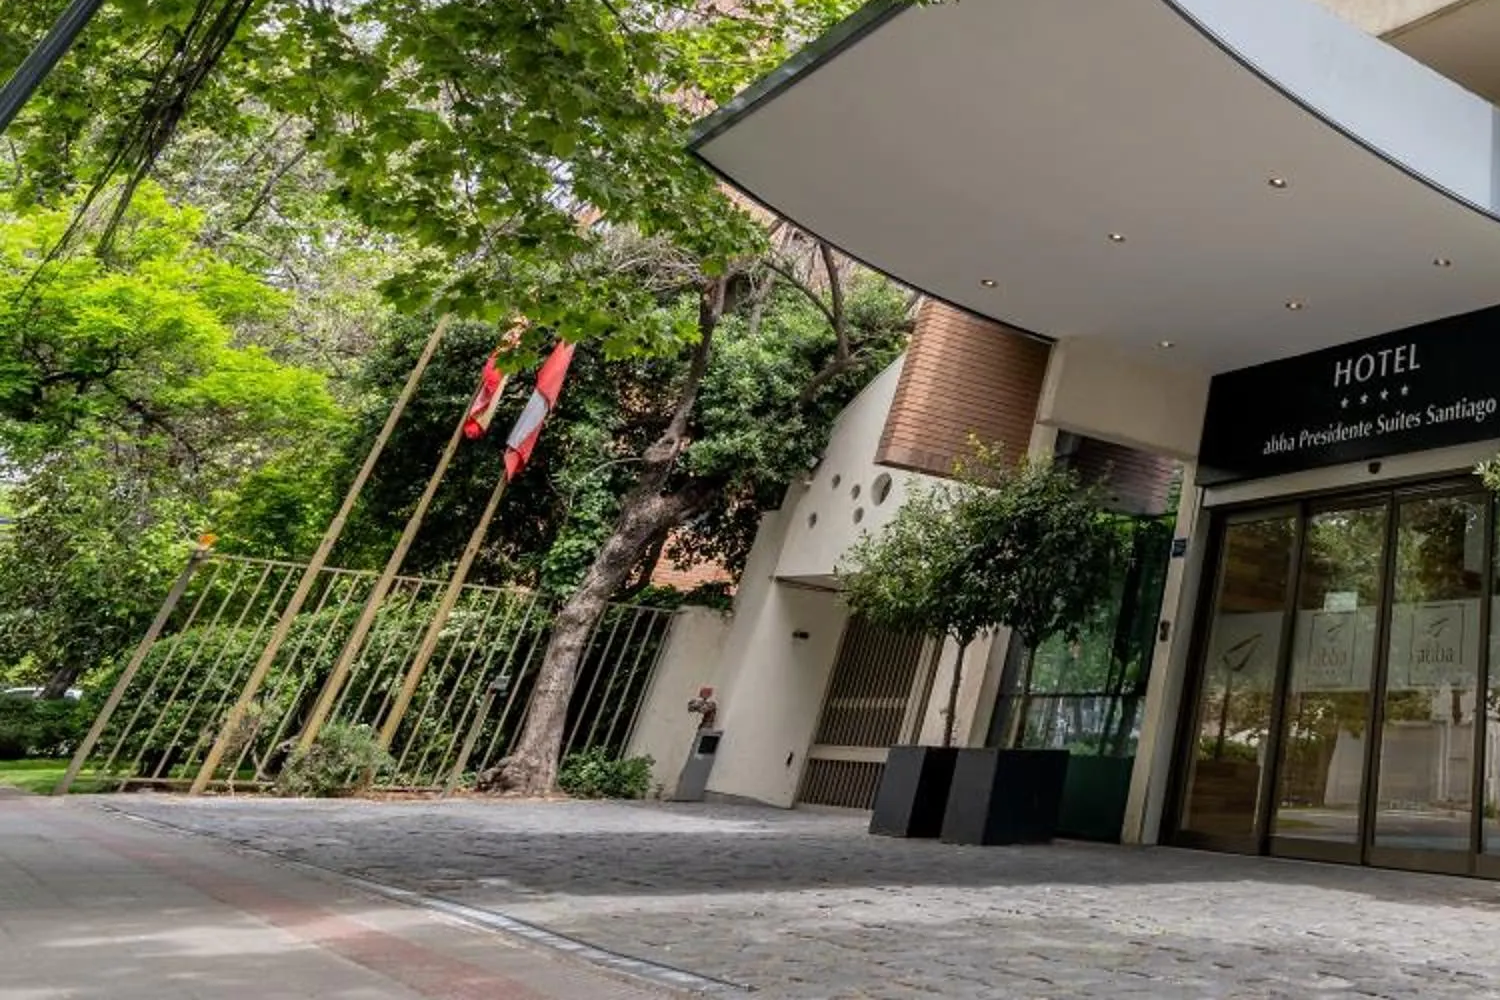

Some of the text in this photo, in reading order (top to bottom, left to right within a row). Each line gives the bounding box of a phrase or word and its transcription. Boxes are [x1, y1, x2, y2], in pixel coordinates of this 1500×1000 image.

[1333, 343, 1421, 388] HOTEL
[1263, 397, 1497, 455] abba Presidente Suites Santiago
